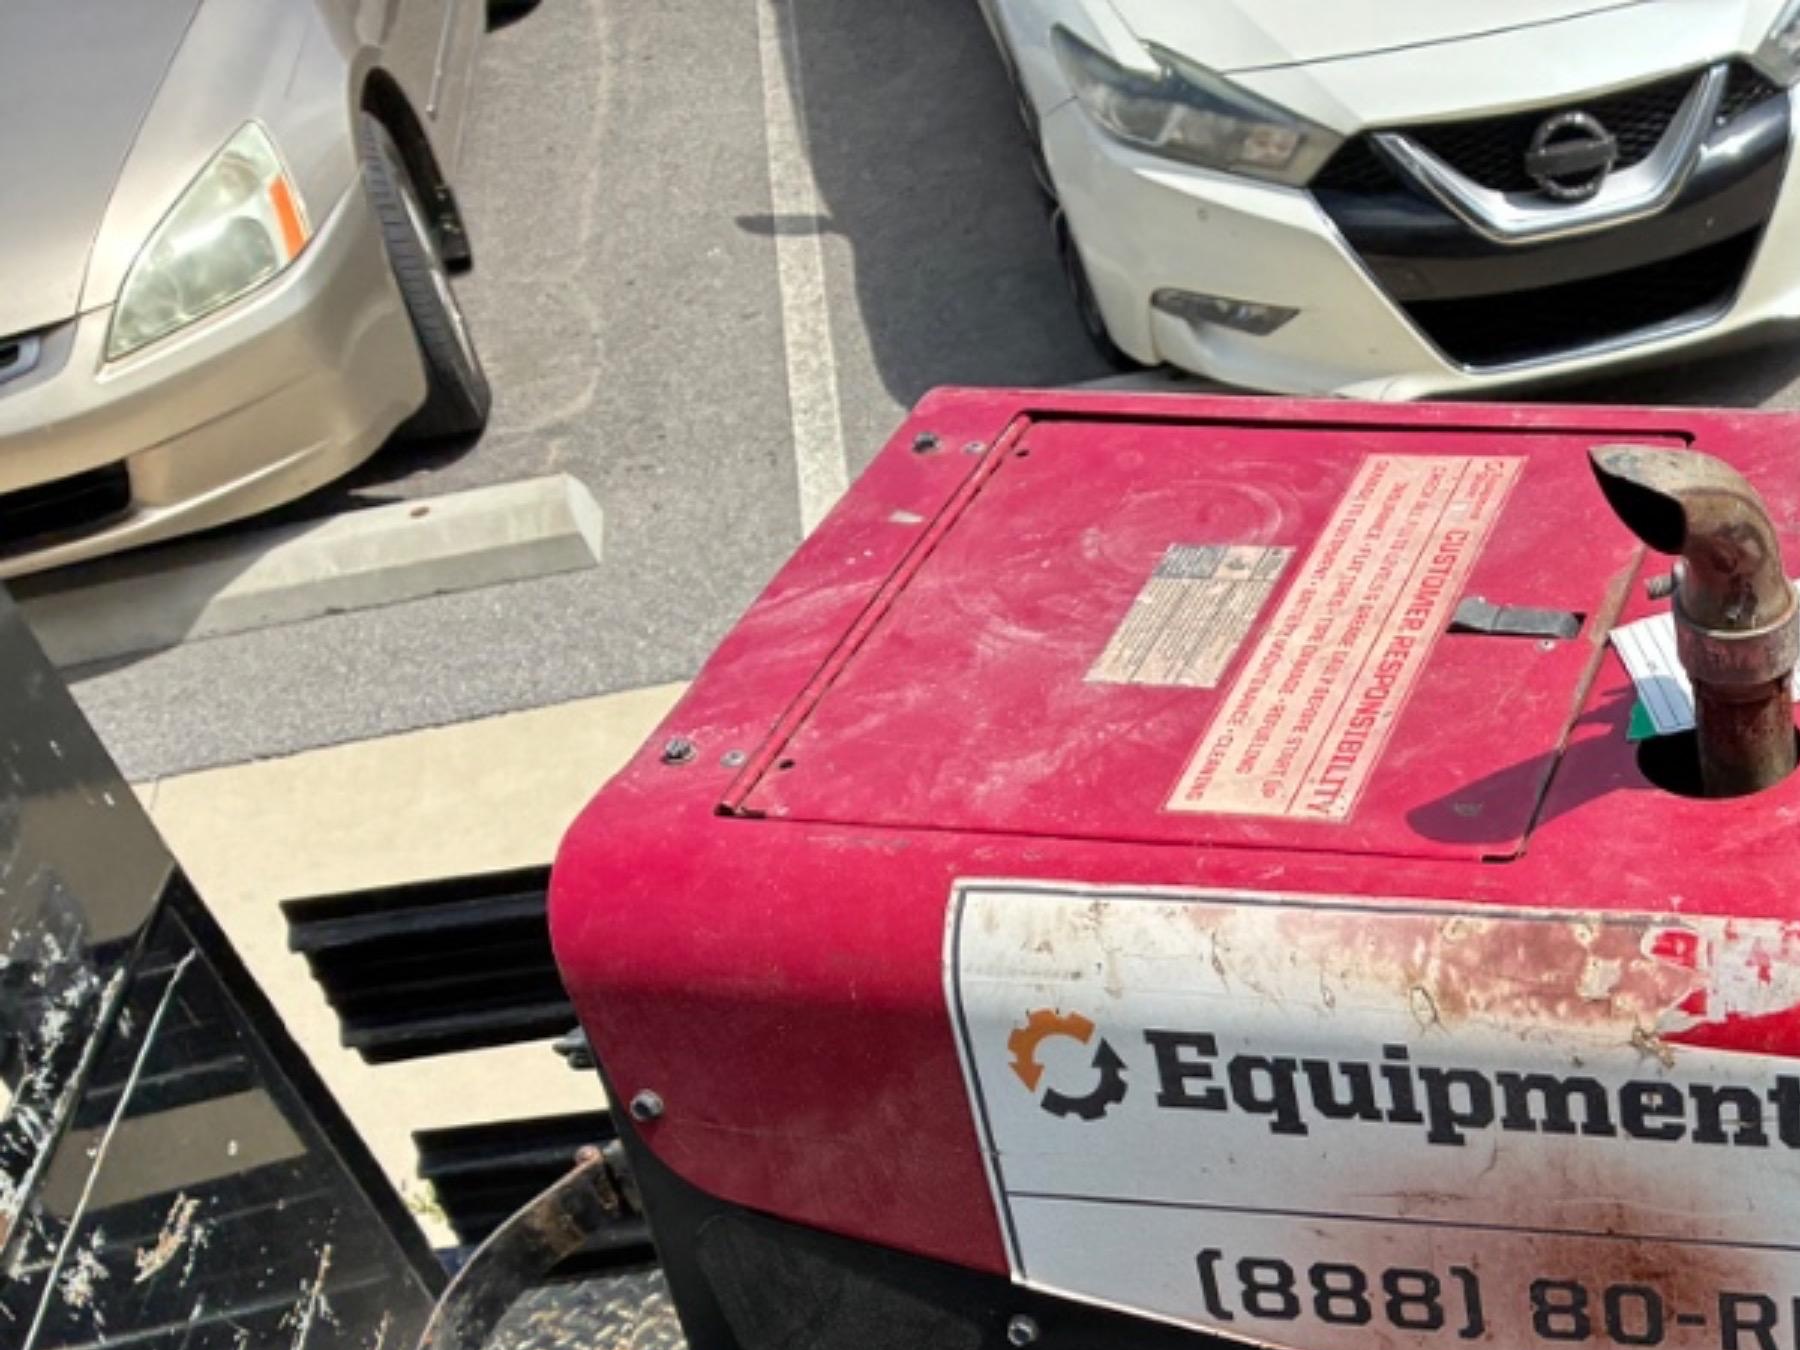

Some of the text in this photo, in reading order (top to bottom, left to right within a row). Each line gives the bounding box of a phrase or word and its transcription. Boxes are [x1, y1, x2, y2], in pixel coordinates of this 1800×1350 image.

[1307, 529, 1470, 813] CUSTOMER RESPONSIBILITY
[1185, 733, 1234, 800] CLEANING
[1197, 1247, 1488, 1339] (888)
